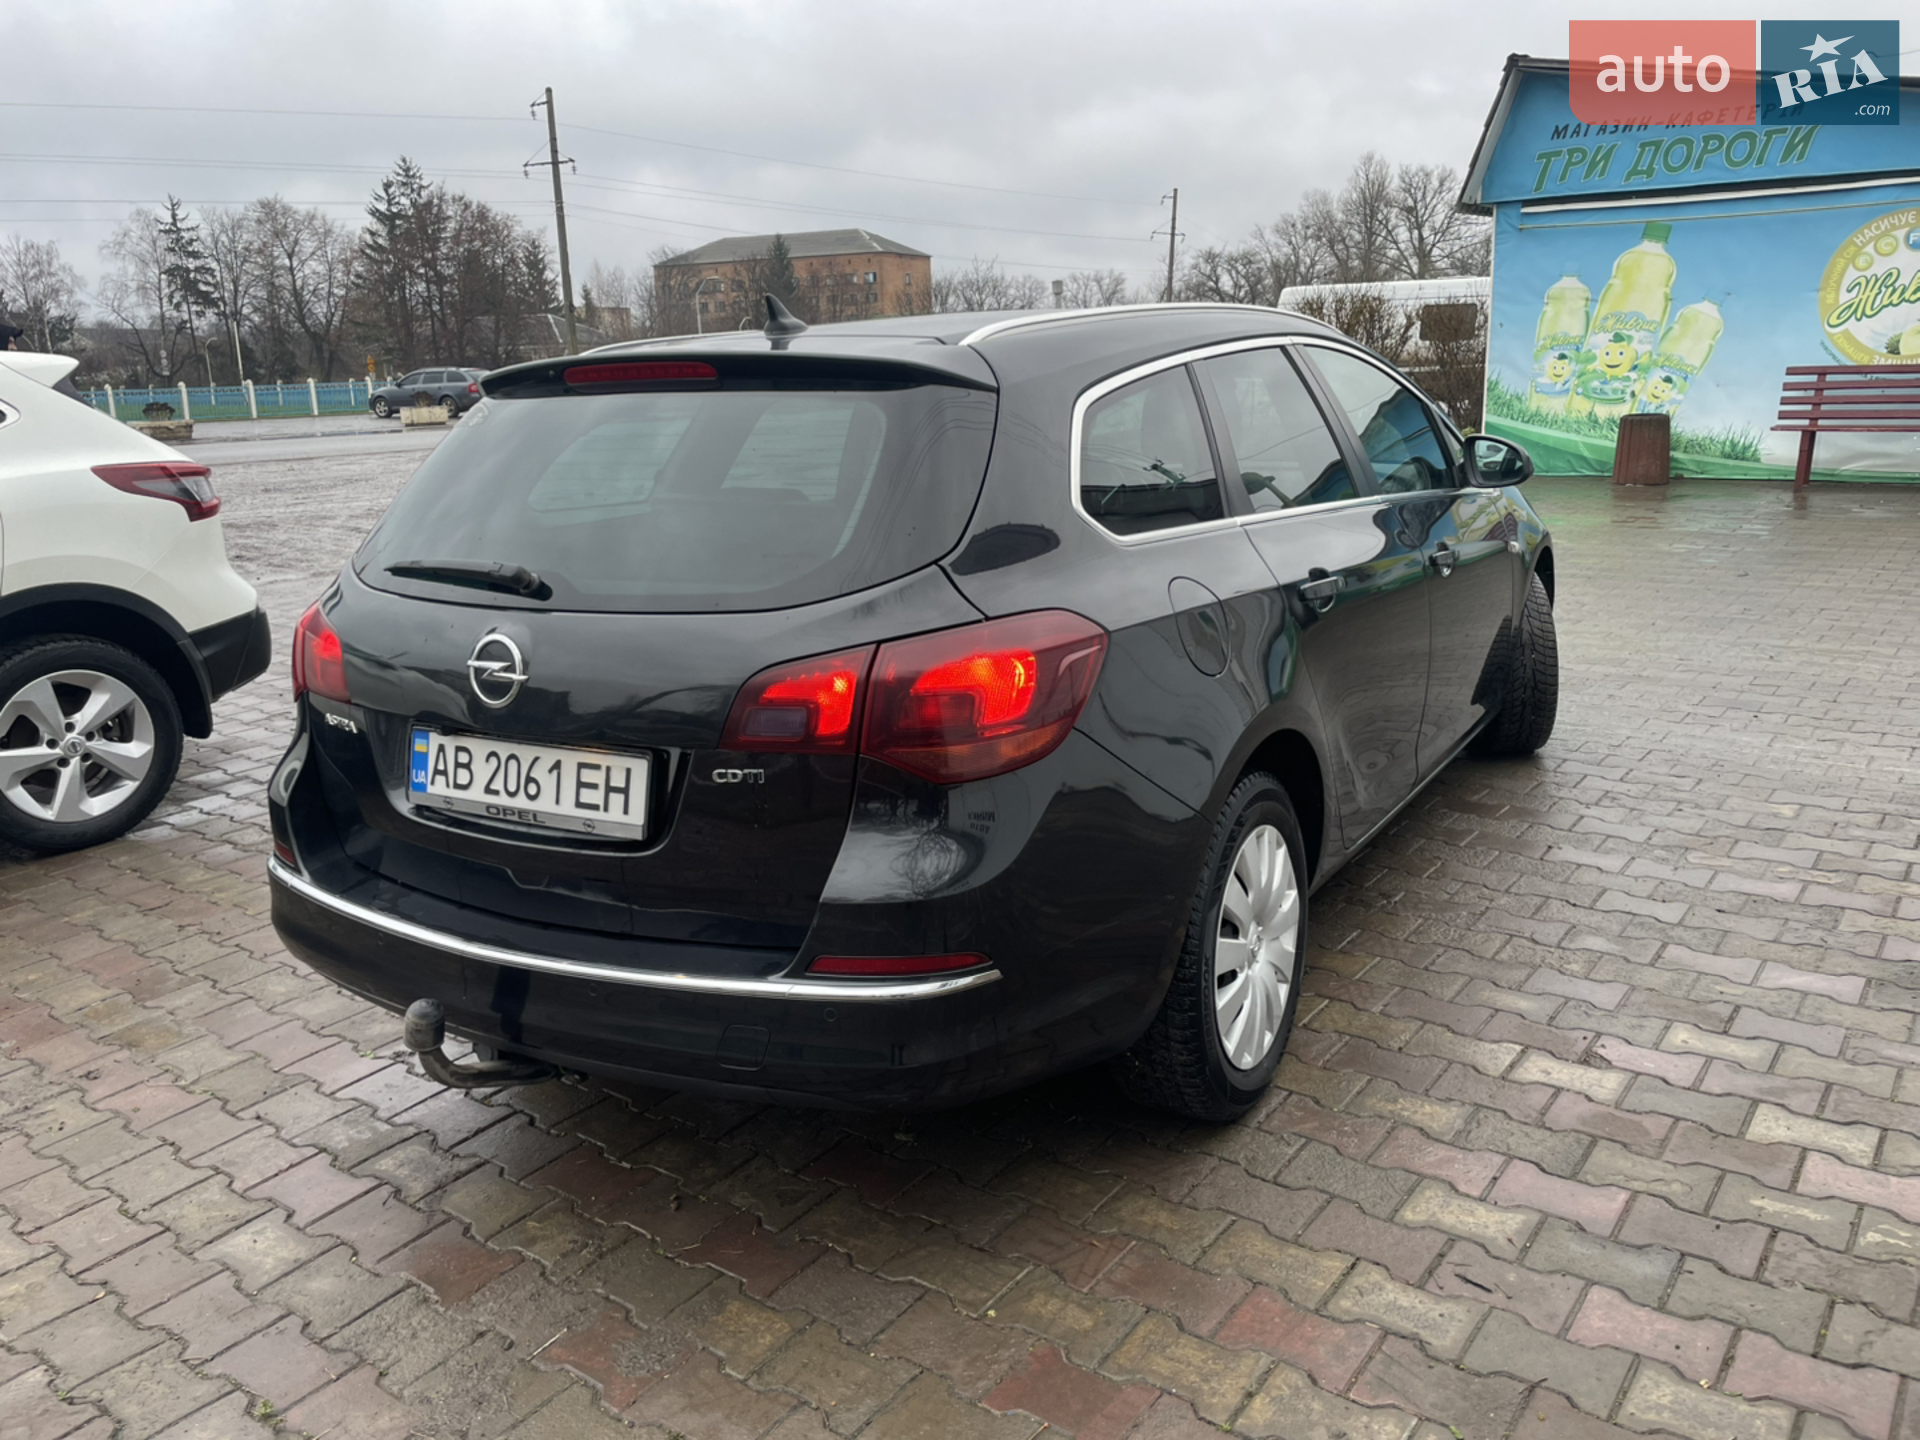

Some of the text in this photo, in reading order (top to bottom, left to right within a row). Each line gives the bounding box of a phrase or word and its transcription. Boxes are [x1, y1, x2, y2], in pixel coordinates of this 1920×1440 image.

[1532, 125, 1822, 194] ТРИ ДОРОГИ
[1853, 211, 1917, 246] НАСИЧУЄ
[324, 712, 358, 734] ASTRA
[412, 769, 427, 784] UA
[430, 743, 632, 815] AB 2061 EH
[712, 768, 765, 784] CDTI
[485, 804, 546, 825] OPEL
